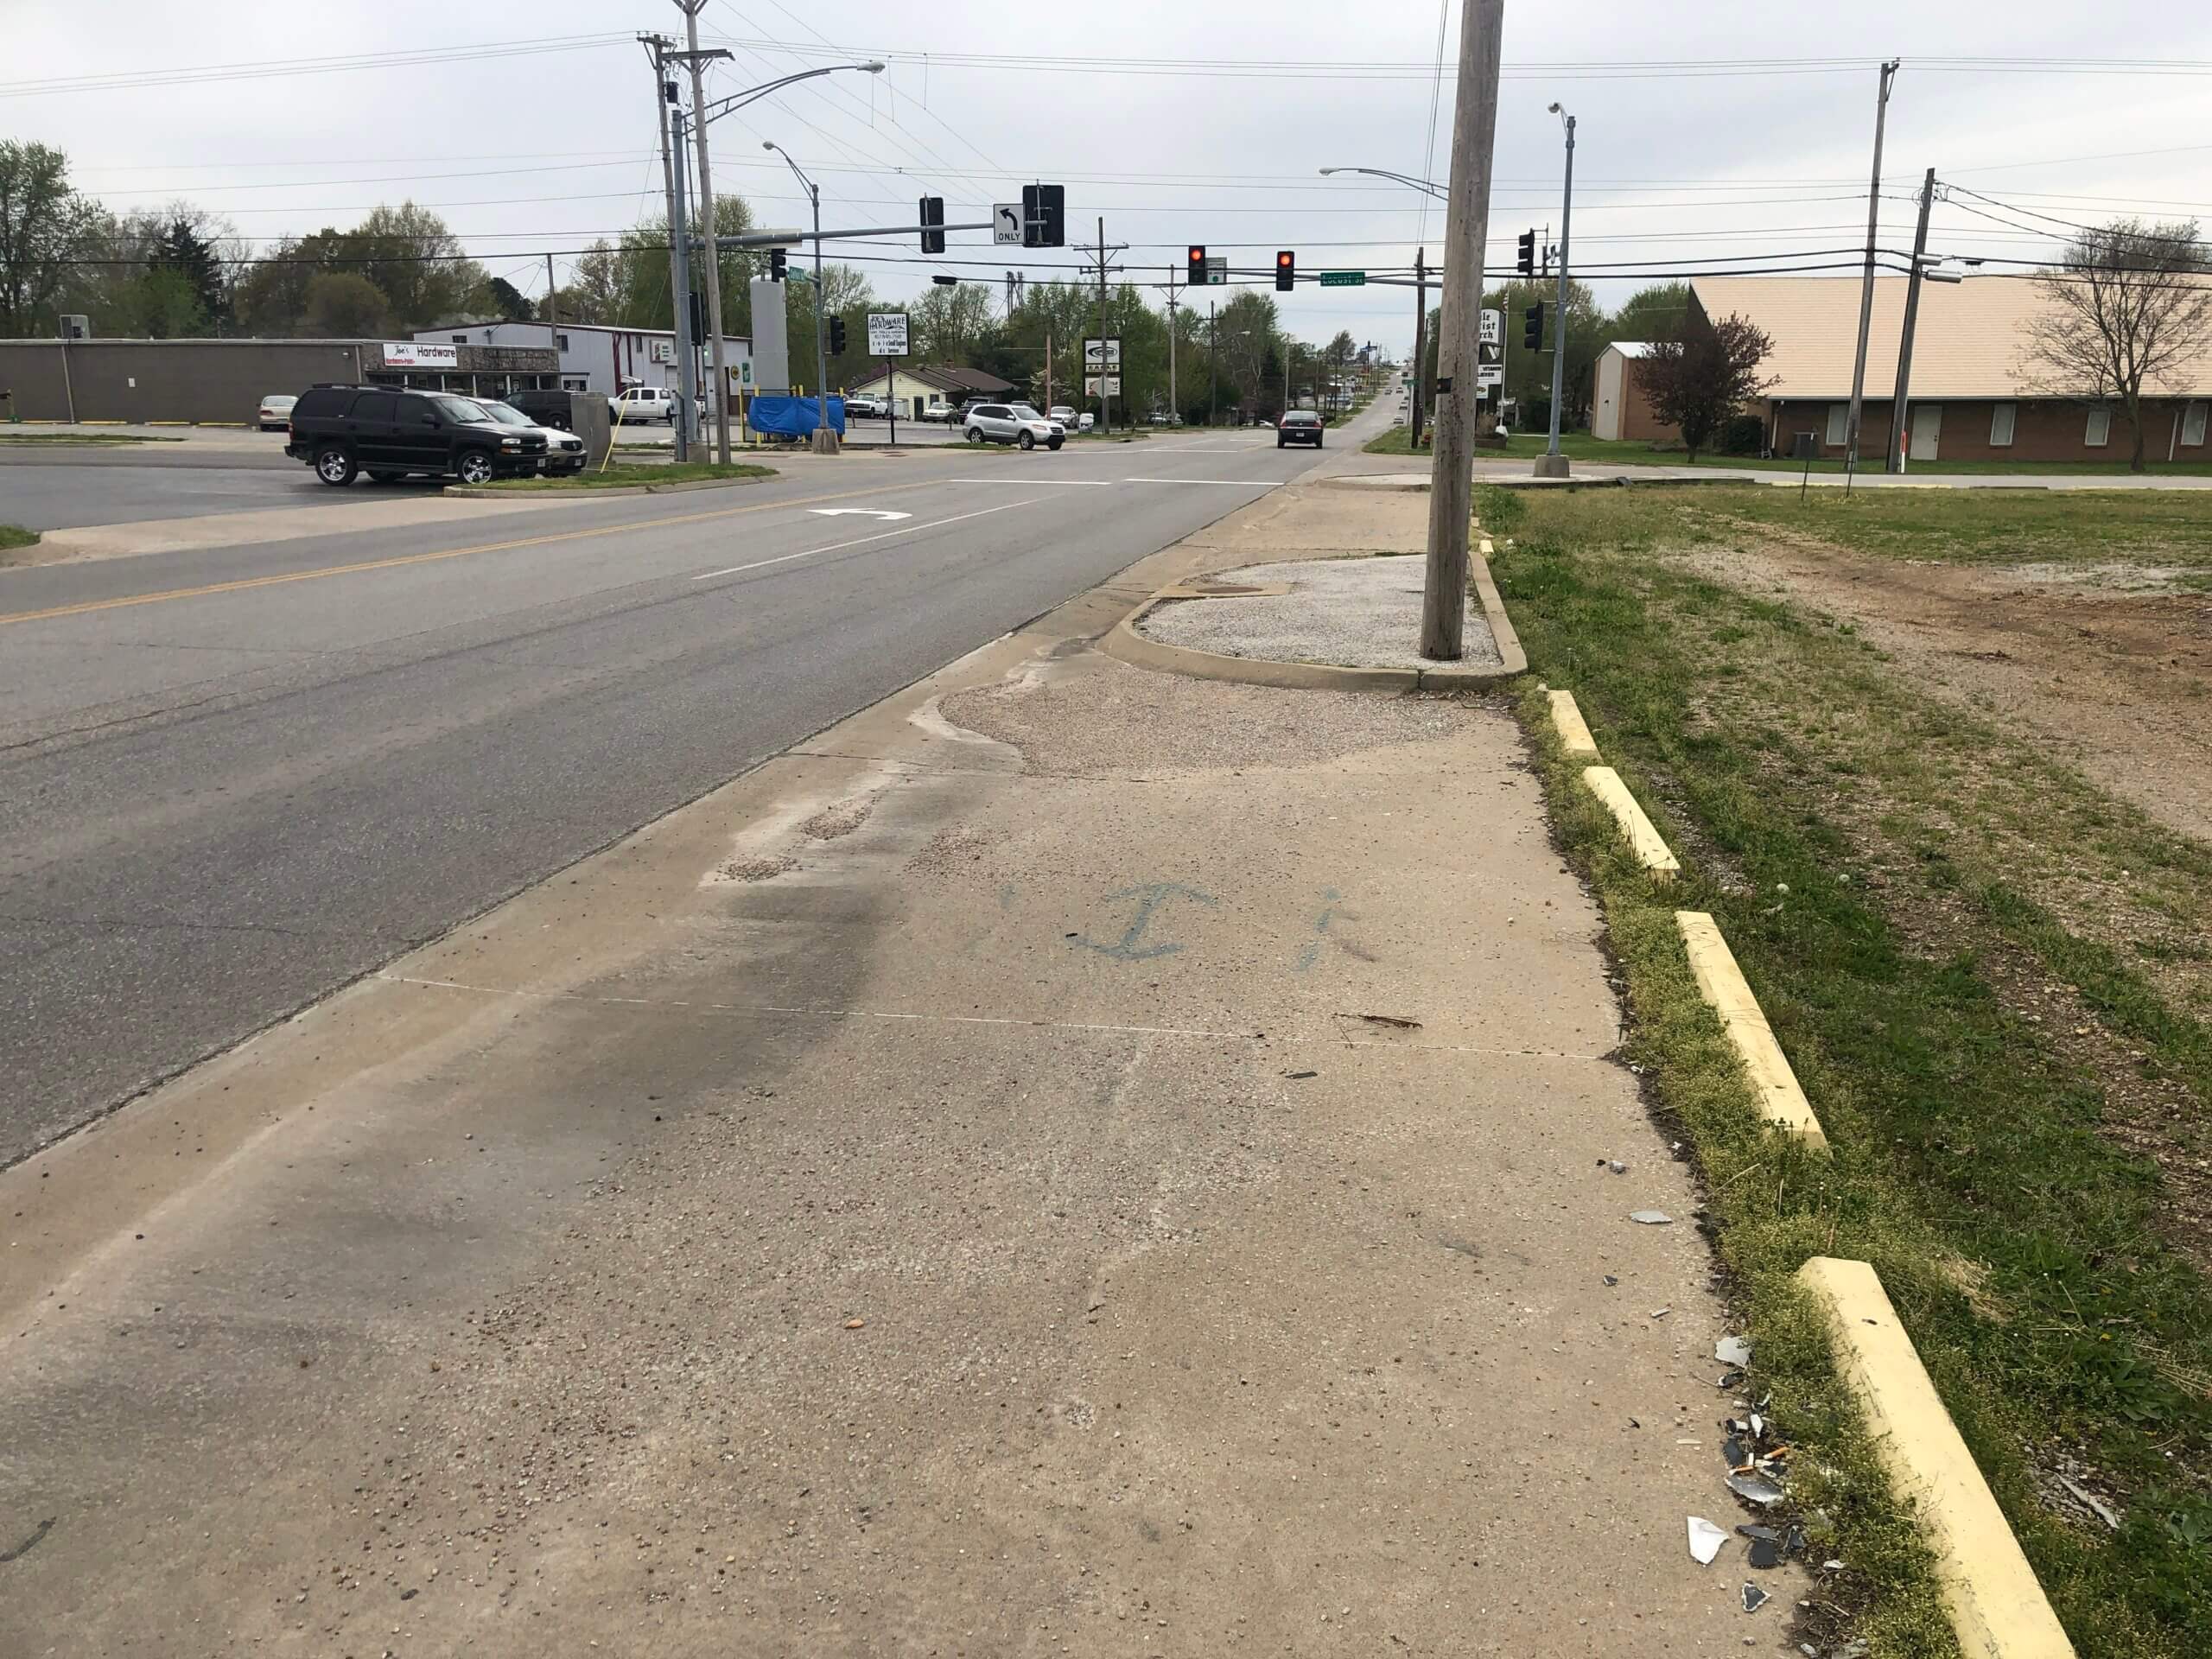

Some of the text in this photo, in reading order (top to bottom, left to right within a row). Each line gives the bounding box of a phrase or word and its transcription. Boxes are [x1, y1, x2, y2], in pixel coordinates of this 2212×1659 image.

[998, 232, 1020, 241] ONLY
[869, 317, 906, 330] HARDWARE
[394, 346, 456, 358] Joe's Hardware
